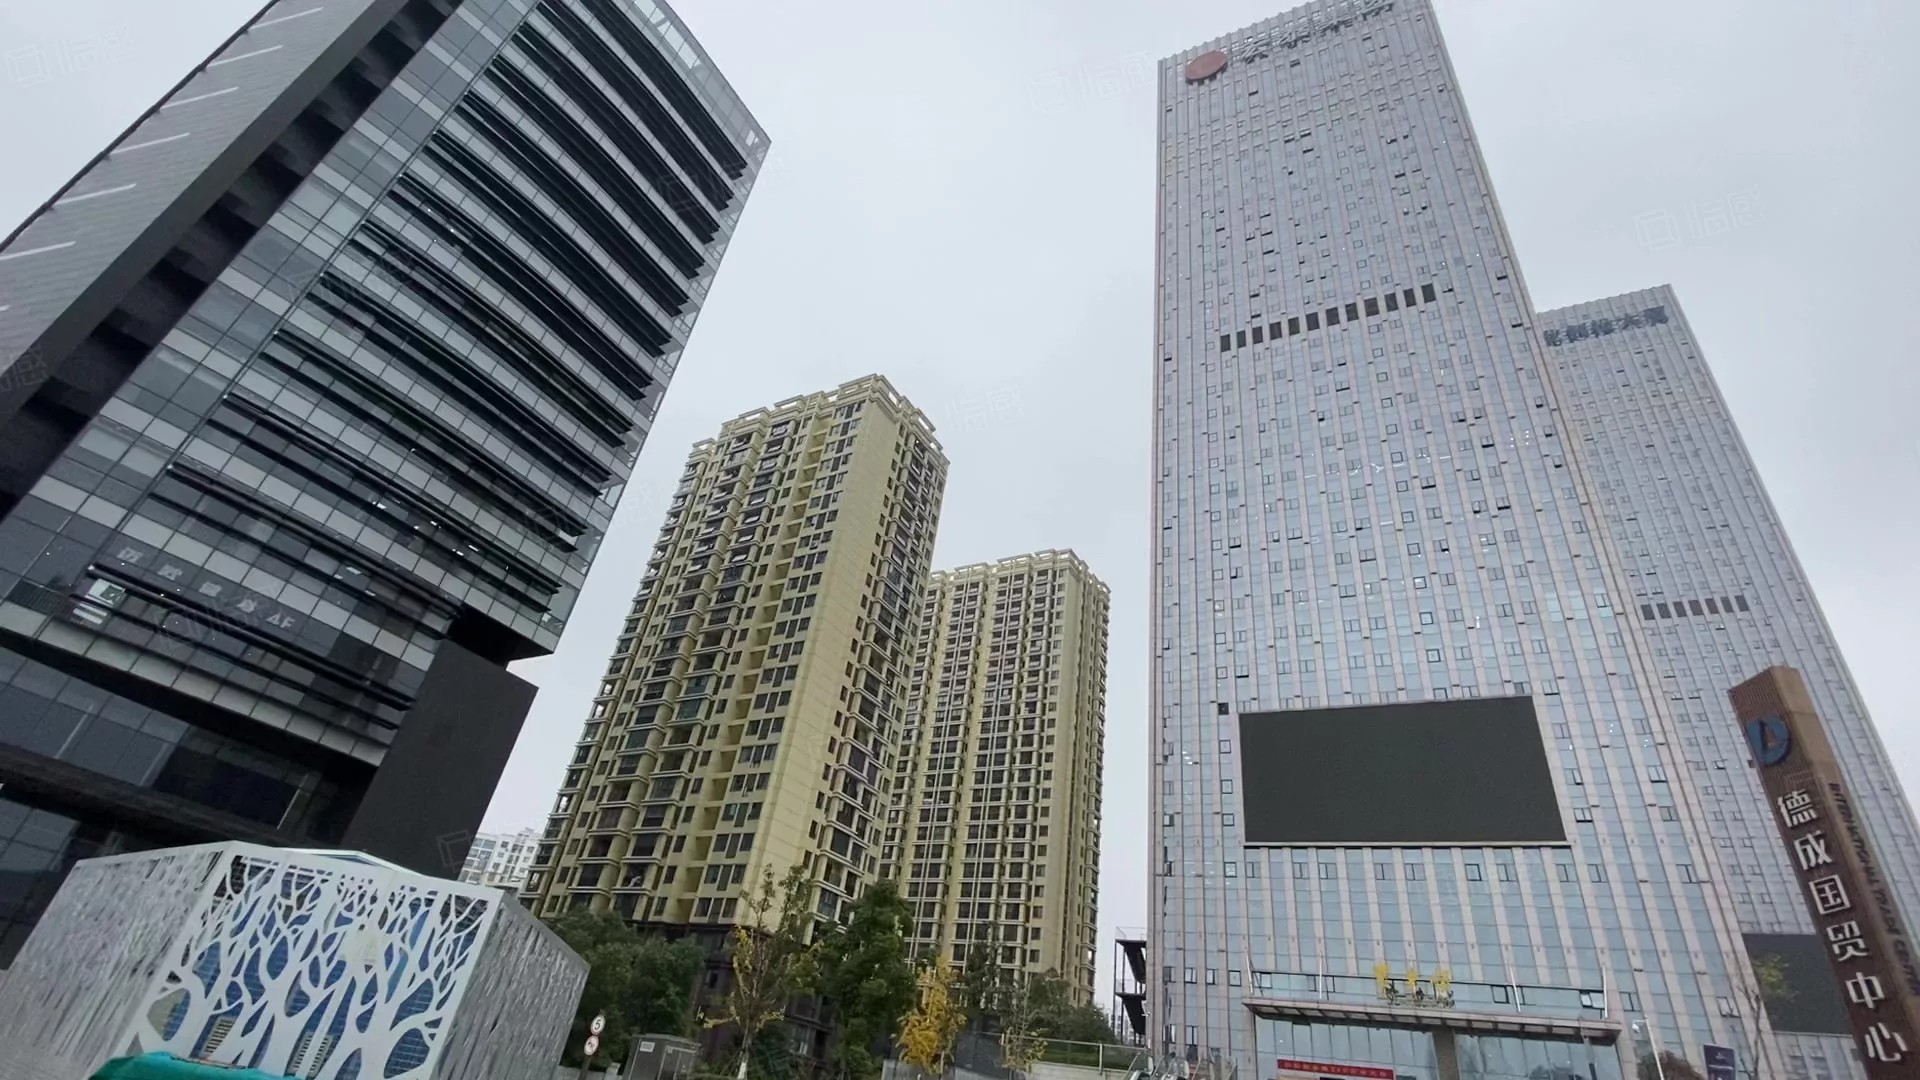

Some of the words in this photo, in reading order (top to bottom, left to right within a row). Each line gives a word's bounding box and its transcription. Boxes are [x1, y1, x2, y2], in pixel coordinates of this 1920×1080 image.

[1777, 788, 1908, 1062] 德成国贸中心
